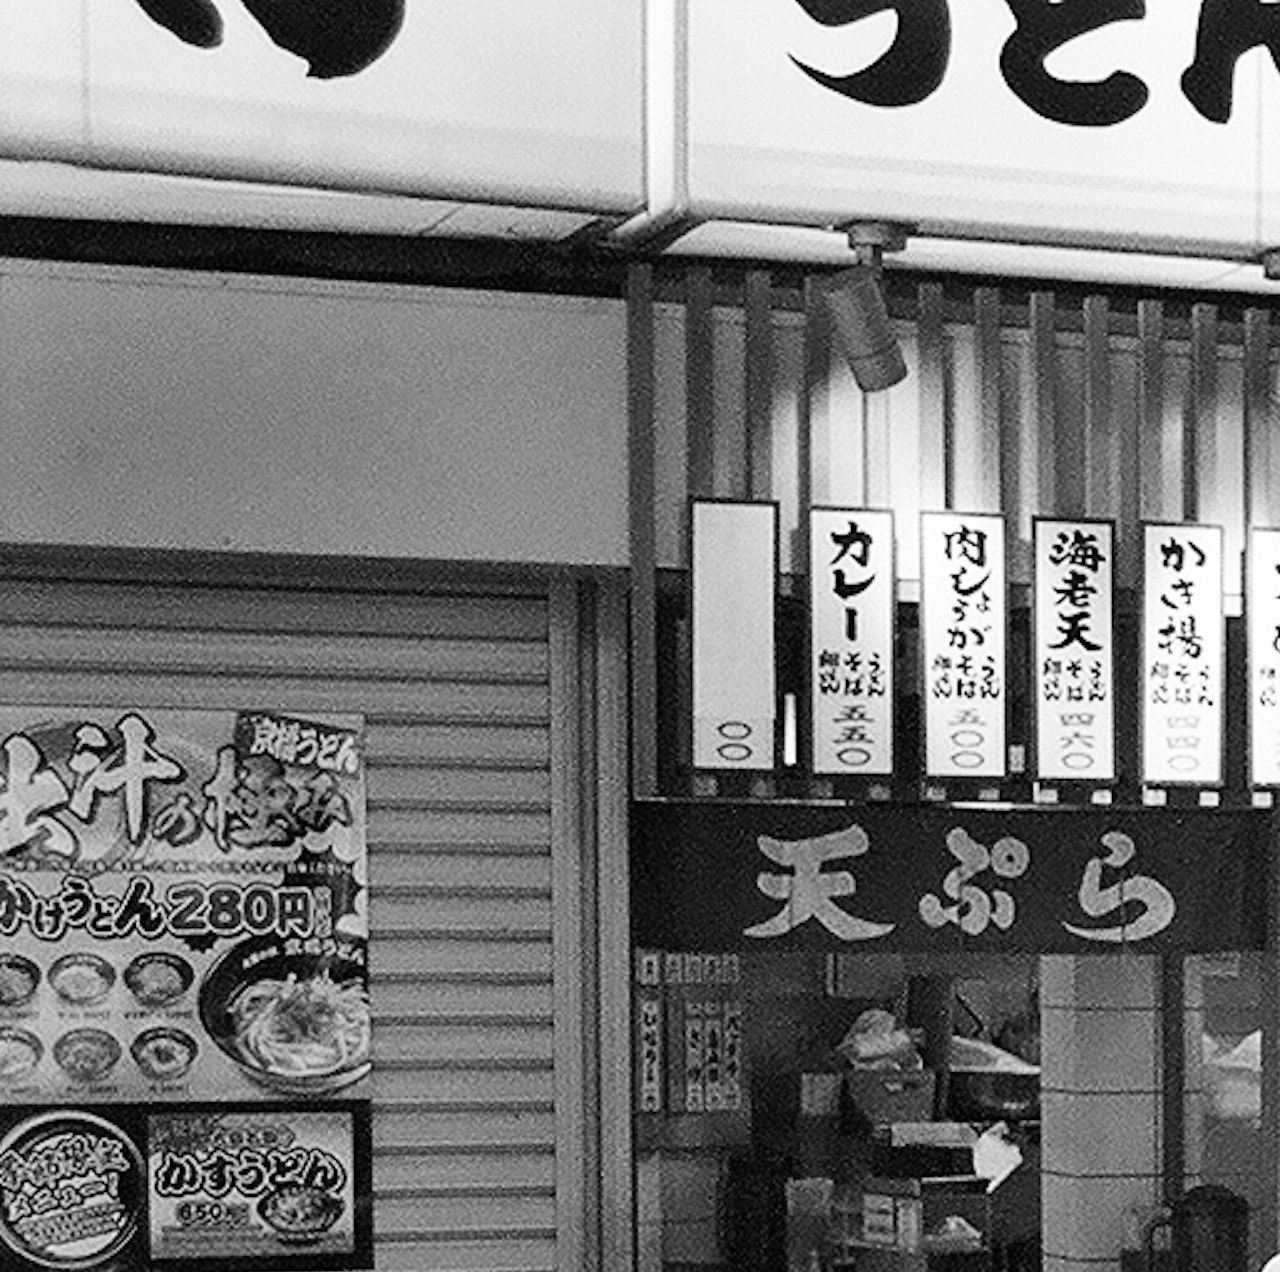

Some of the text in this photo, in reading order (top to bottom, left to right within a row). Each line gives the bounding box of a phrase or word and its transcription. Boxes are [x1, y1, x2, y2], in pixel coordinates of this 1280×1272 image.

[830, 521, 877, 642] カレー
[1049, 530, 1106, 651] 海老天
[1159, 538, 1206, 660] かき揚
[743, 824, 1178, 942] 天ぷら
[155, 1149, 348, 1197] かすうどん
